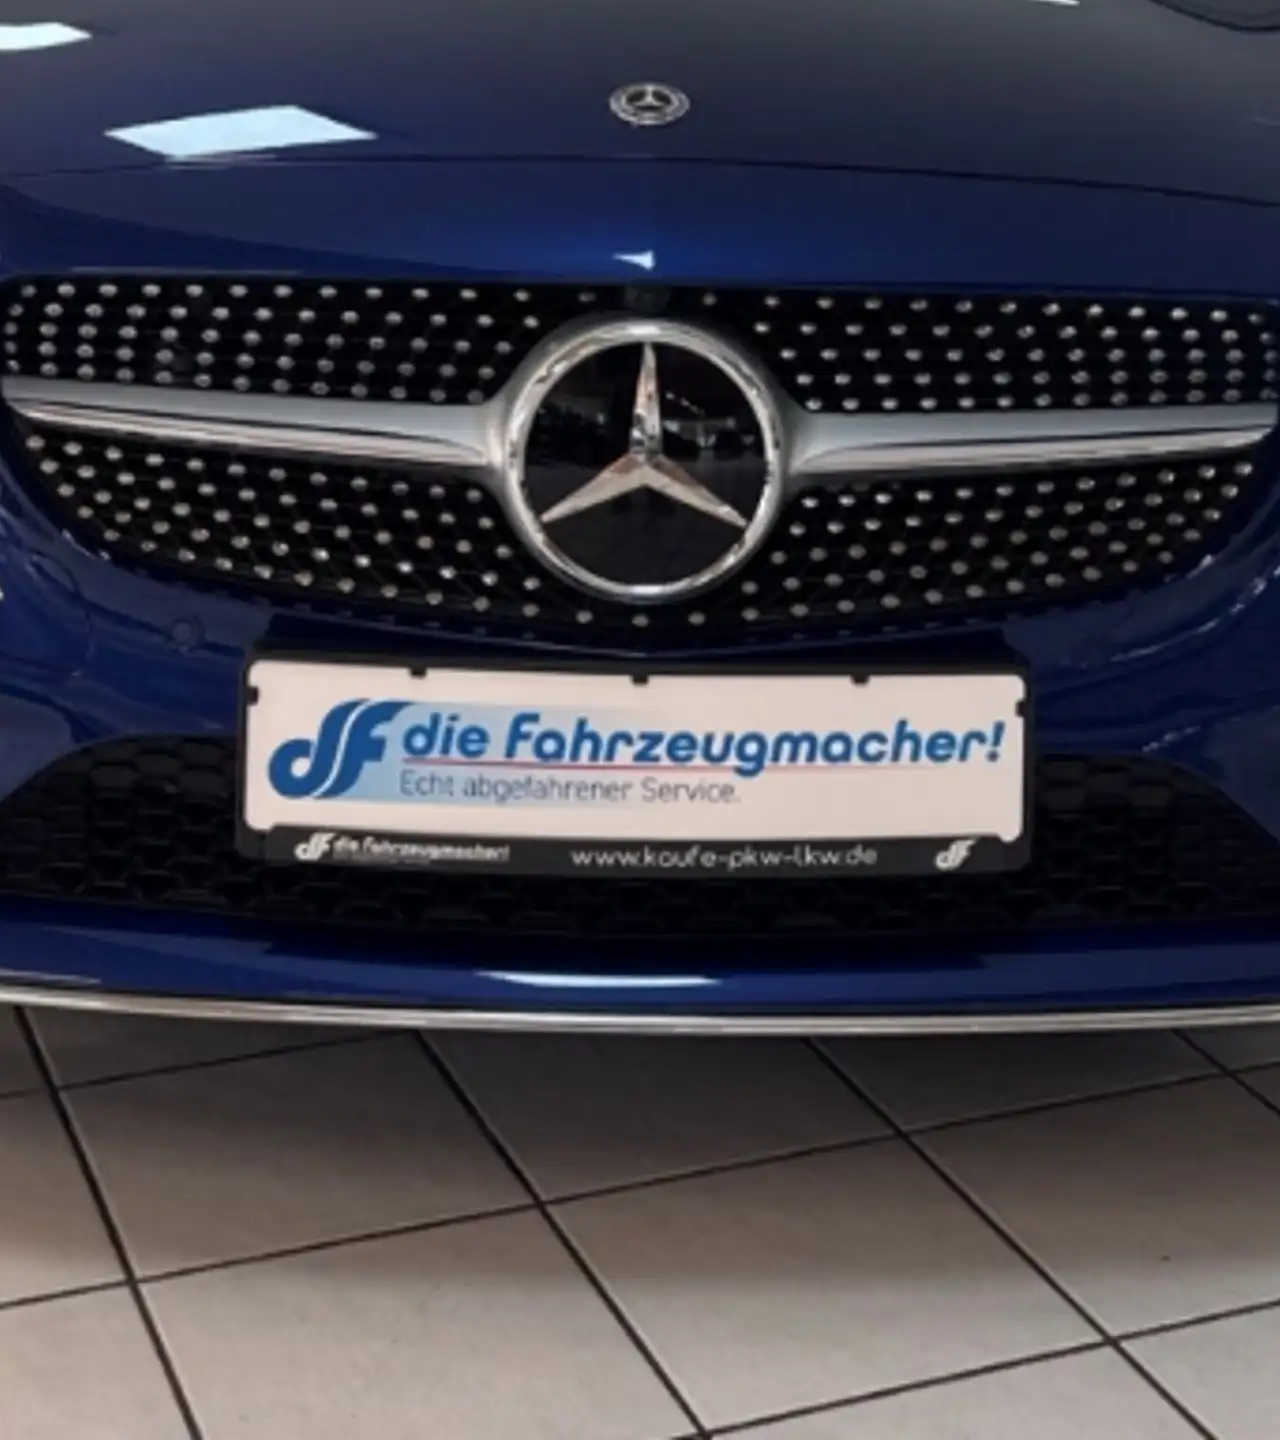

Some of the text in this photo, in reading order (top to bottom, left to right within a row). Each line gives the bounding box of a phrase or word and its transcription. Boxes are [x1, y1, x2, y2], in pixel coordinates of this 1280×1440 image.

[403, 712, 1005, 777] die Fahrzeugmacher!
[399, 769, 741, 804] Echt abgefahrener Service.
[333, 836, 360, 854] die
[571, 844, 878, 872] www.kaufe-pkw-lkw.de
